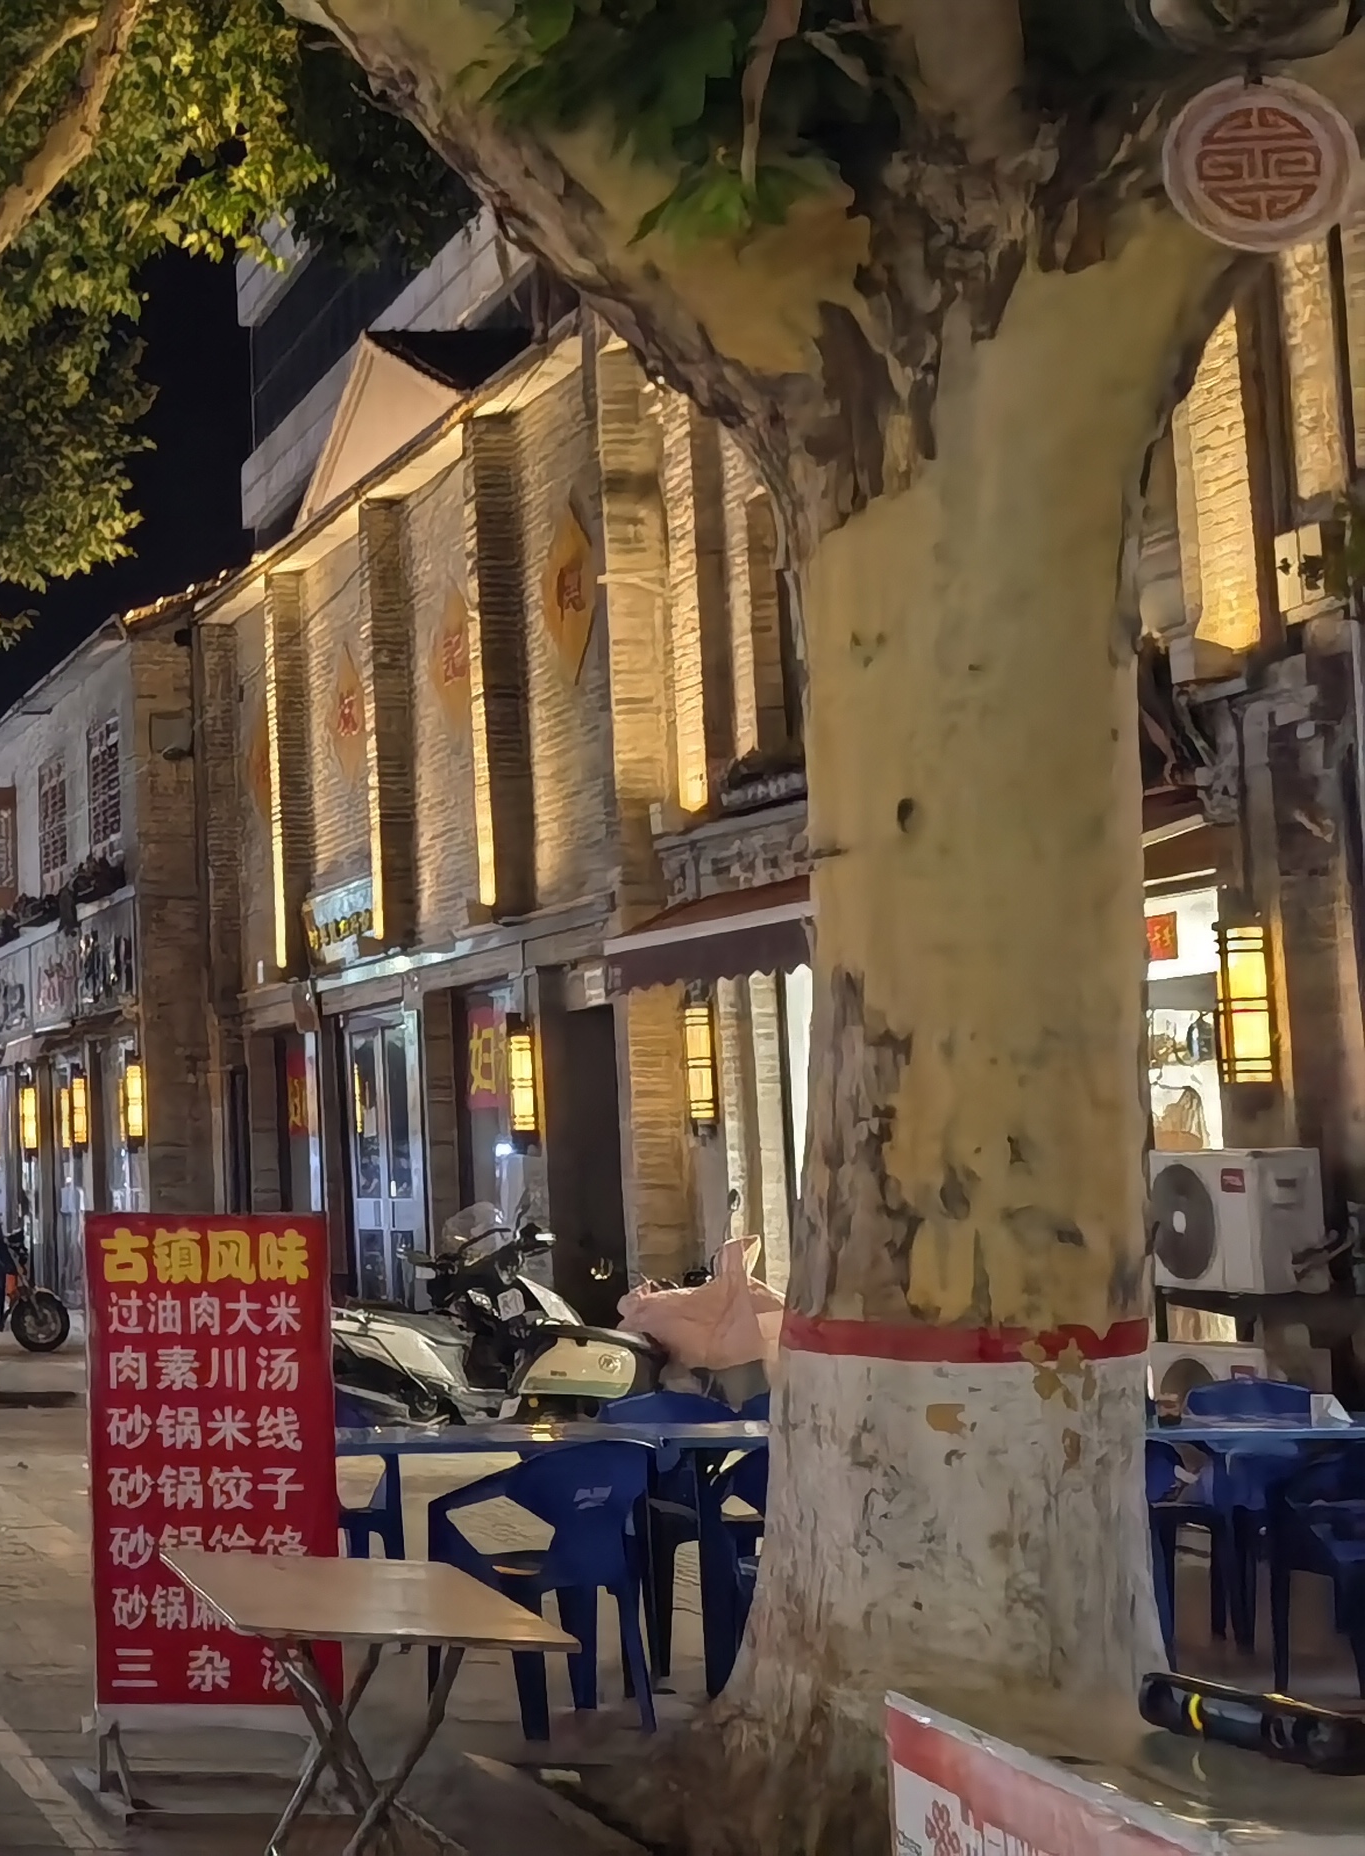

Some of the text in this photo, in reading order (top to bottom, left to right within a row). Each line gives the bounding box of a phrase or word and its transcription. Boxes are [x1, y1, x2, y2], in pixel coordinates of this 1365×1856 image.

[99, 1228, 309, 1285] 古镇风味
[108, 1290, 302, 1335] 过油肉大米
[108, 1345, 299, 1392] 肉素川汤
[107, 1405, 303, 1451] 砂锅米线
[107, 1466, 304, 1511] 砂锅饺子
